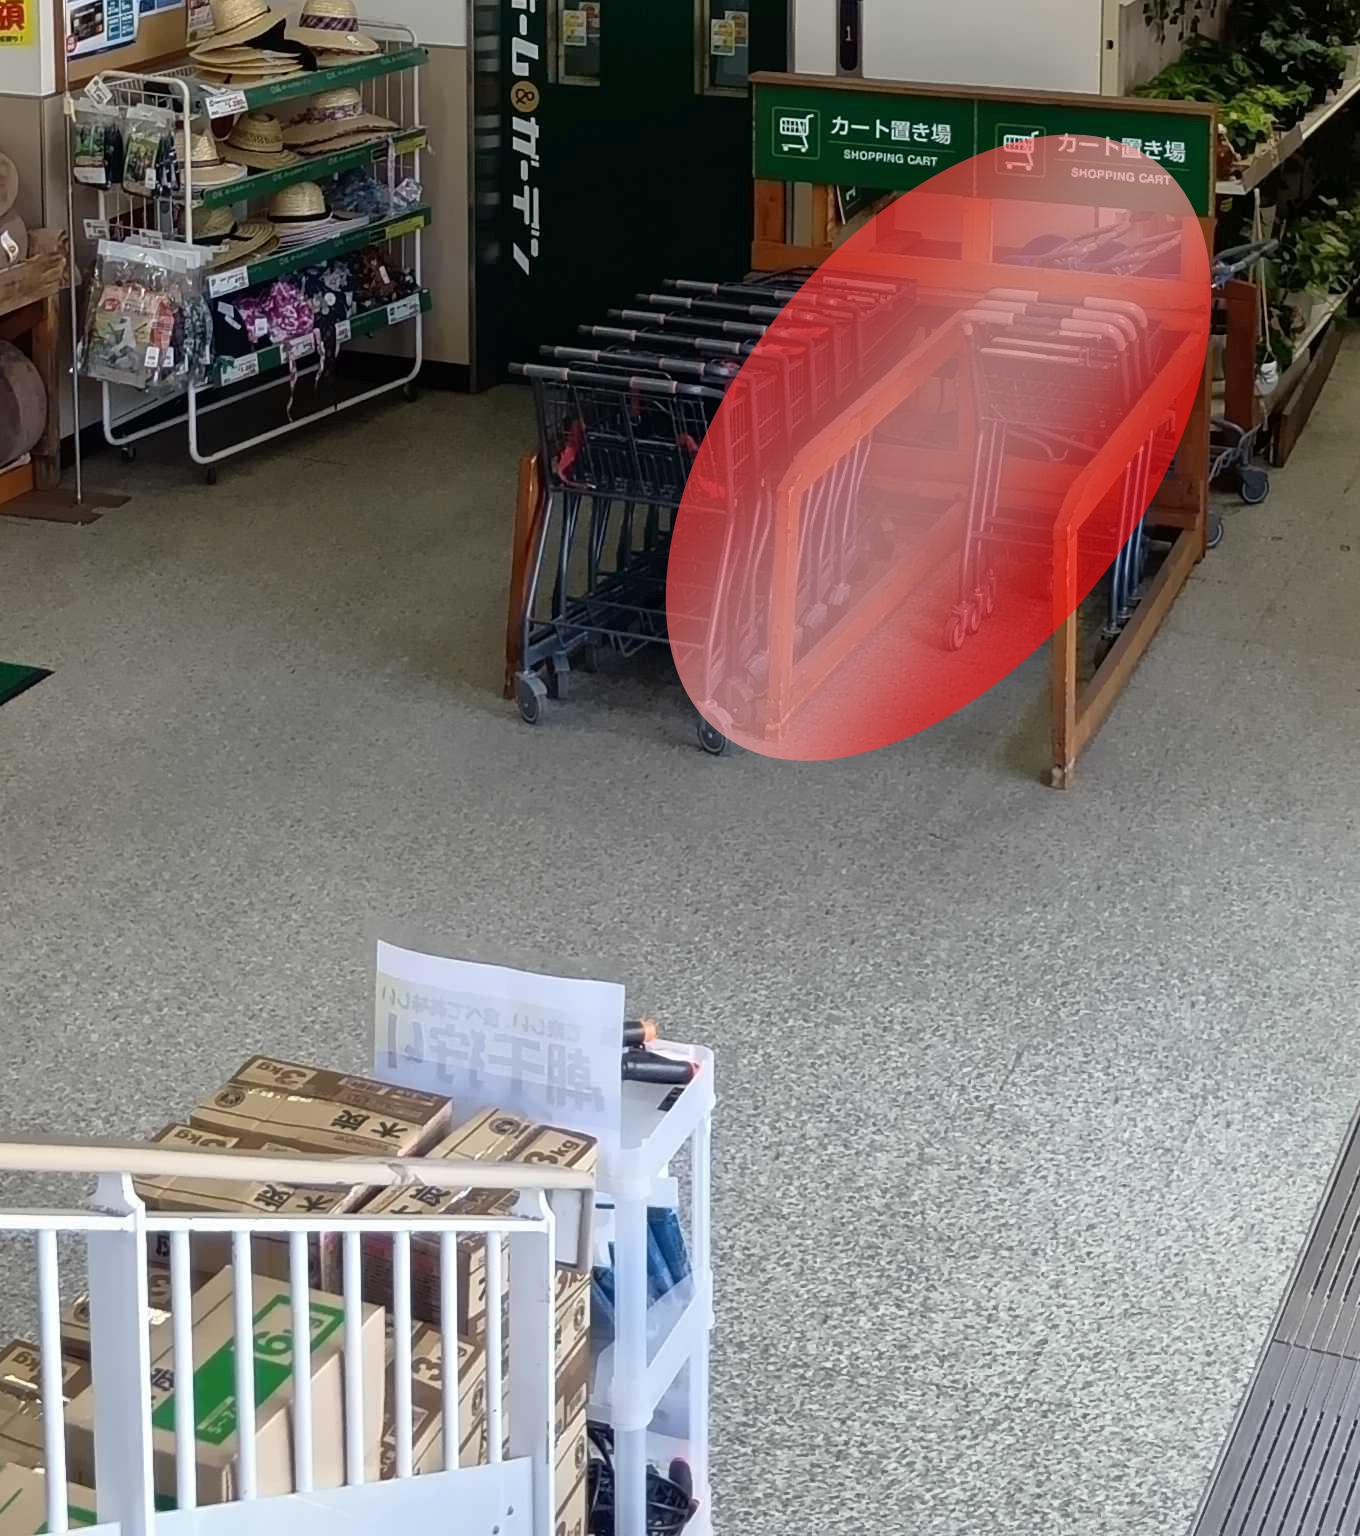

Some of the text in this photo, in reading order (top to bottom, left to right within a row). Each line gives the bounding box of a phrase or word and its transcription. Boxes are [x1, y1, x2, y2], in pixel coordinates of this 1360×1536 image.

[830, 116, 952, 146] カート置き場
[843, 149, 938, 168] SHOPPING CART
[1057, 133, 1186, 164] カート置き場
[1070, 167, 1172, 187] SHOPPING CART
[256, 1060, 310, 1087] 3kg
[330, 1107, 409, 1140] 木炭
